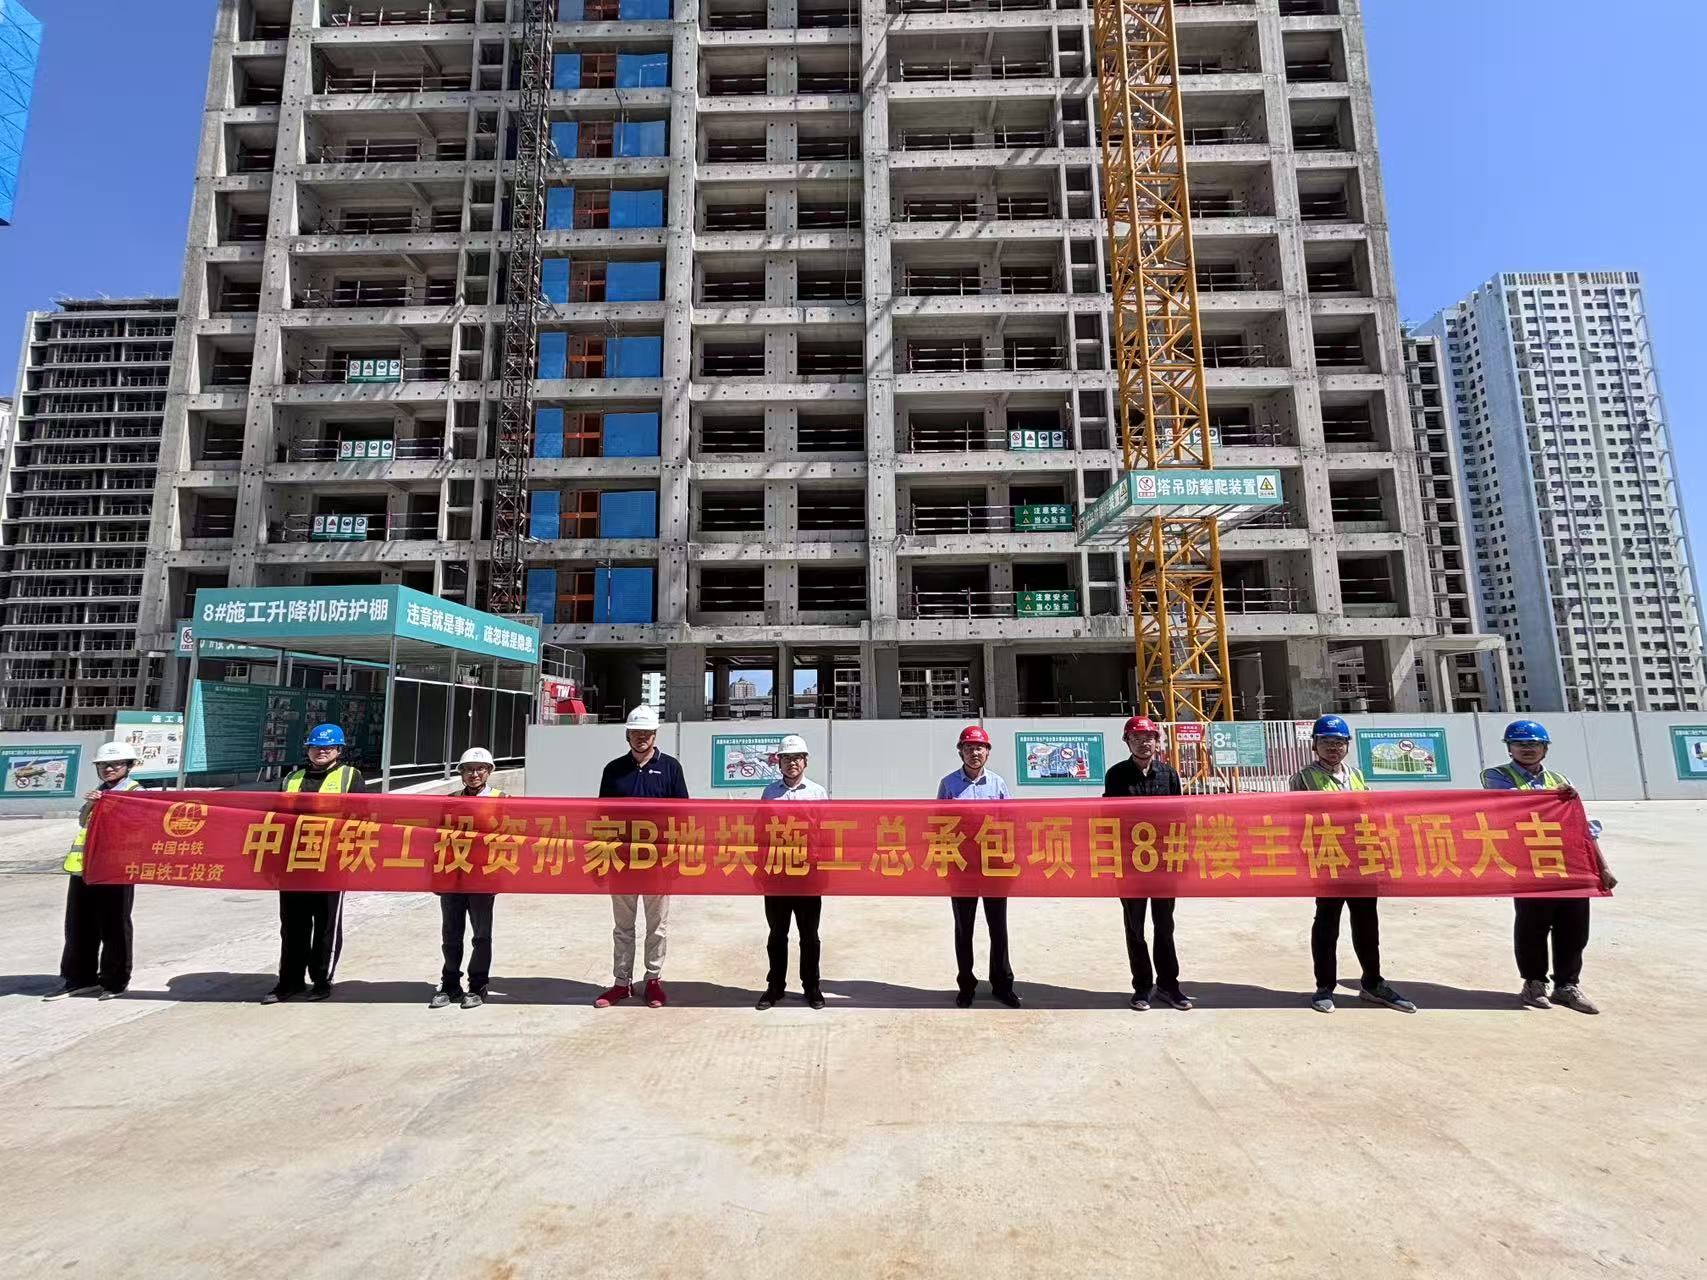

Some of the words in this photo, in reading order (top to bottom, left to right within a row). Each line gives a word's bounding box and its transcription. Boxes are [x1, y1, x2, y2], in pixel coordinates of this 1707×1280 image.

[1157, 478, 1257, 496] 塔吊防攀爬装置
[1033, 506, 1066, 515] 注意安全
[1034, 516, 1067, 524] 当心坠落
[1035, 593, 1069, 602] 注意安全
[203, 598, 389, 624] 8#施工升降机防护棚
[1036, 602, 1070, 611] 当心坠落
[151, 840, 204, 856] 中国中铁
[242, 811, 1569, 881] 中国铁工投资孙家B地块施工总承包项目8#楼主体封顶大吉
[125, 862, 225, 882] 中国铁工投资
